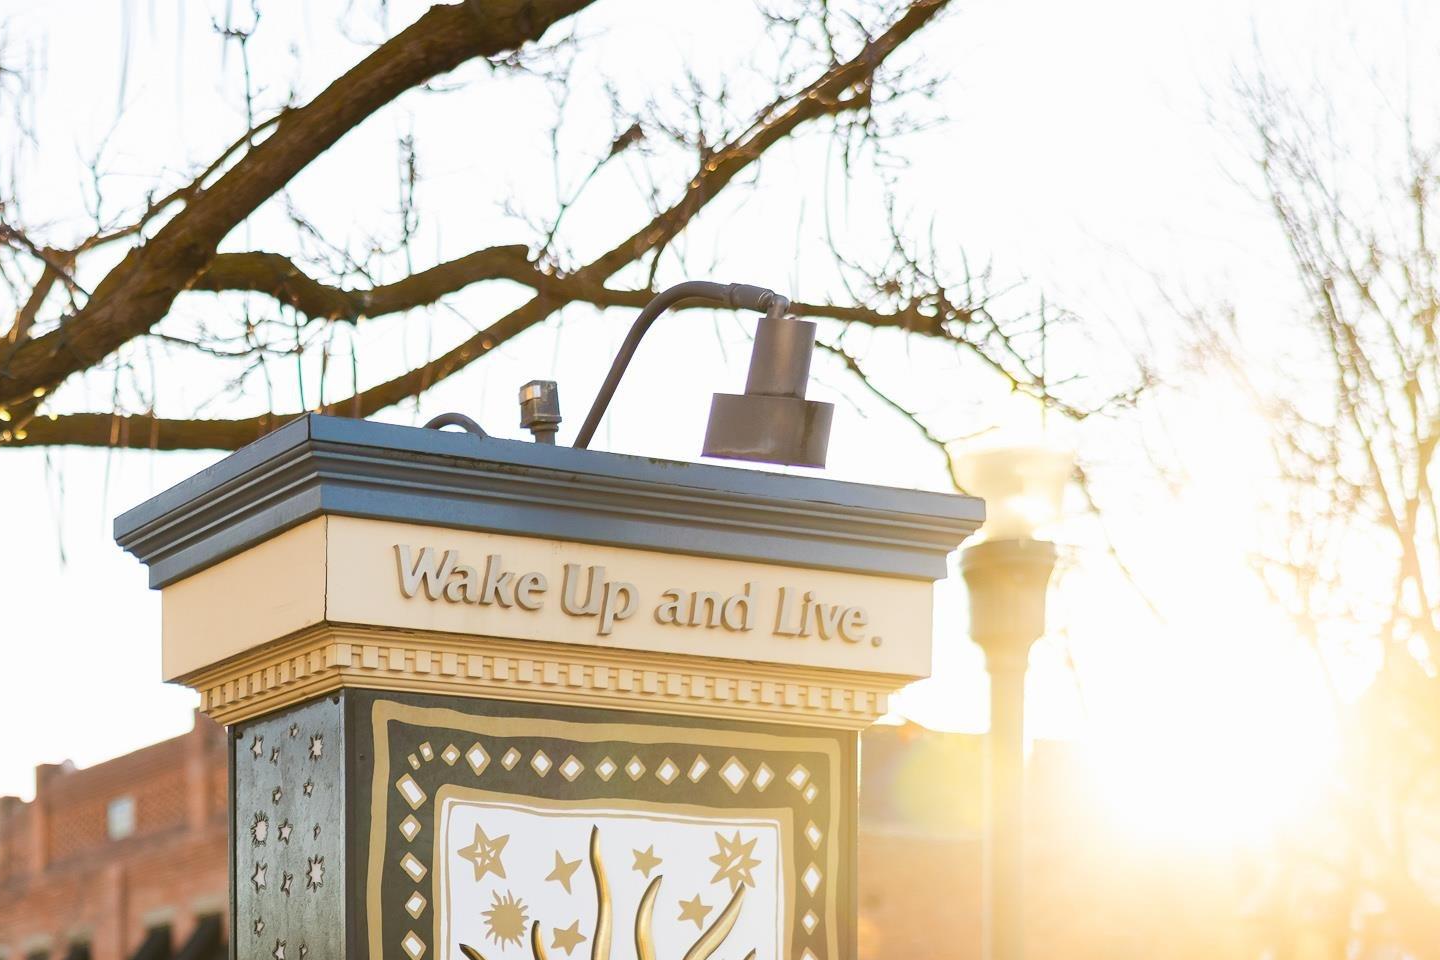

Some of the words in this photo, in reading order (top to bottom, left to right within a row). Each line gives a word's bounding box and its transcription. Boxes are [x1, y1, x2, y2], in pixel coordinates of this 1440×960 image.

[392, 543, 548, 611] Wake
[561, 563, 639, 635] Up
[654, 581, 759, 633] and
[772, 586, 883, 648] Live.
